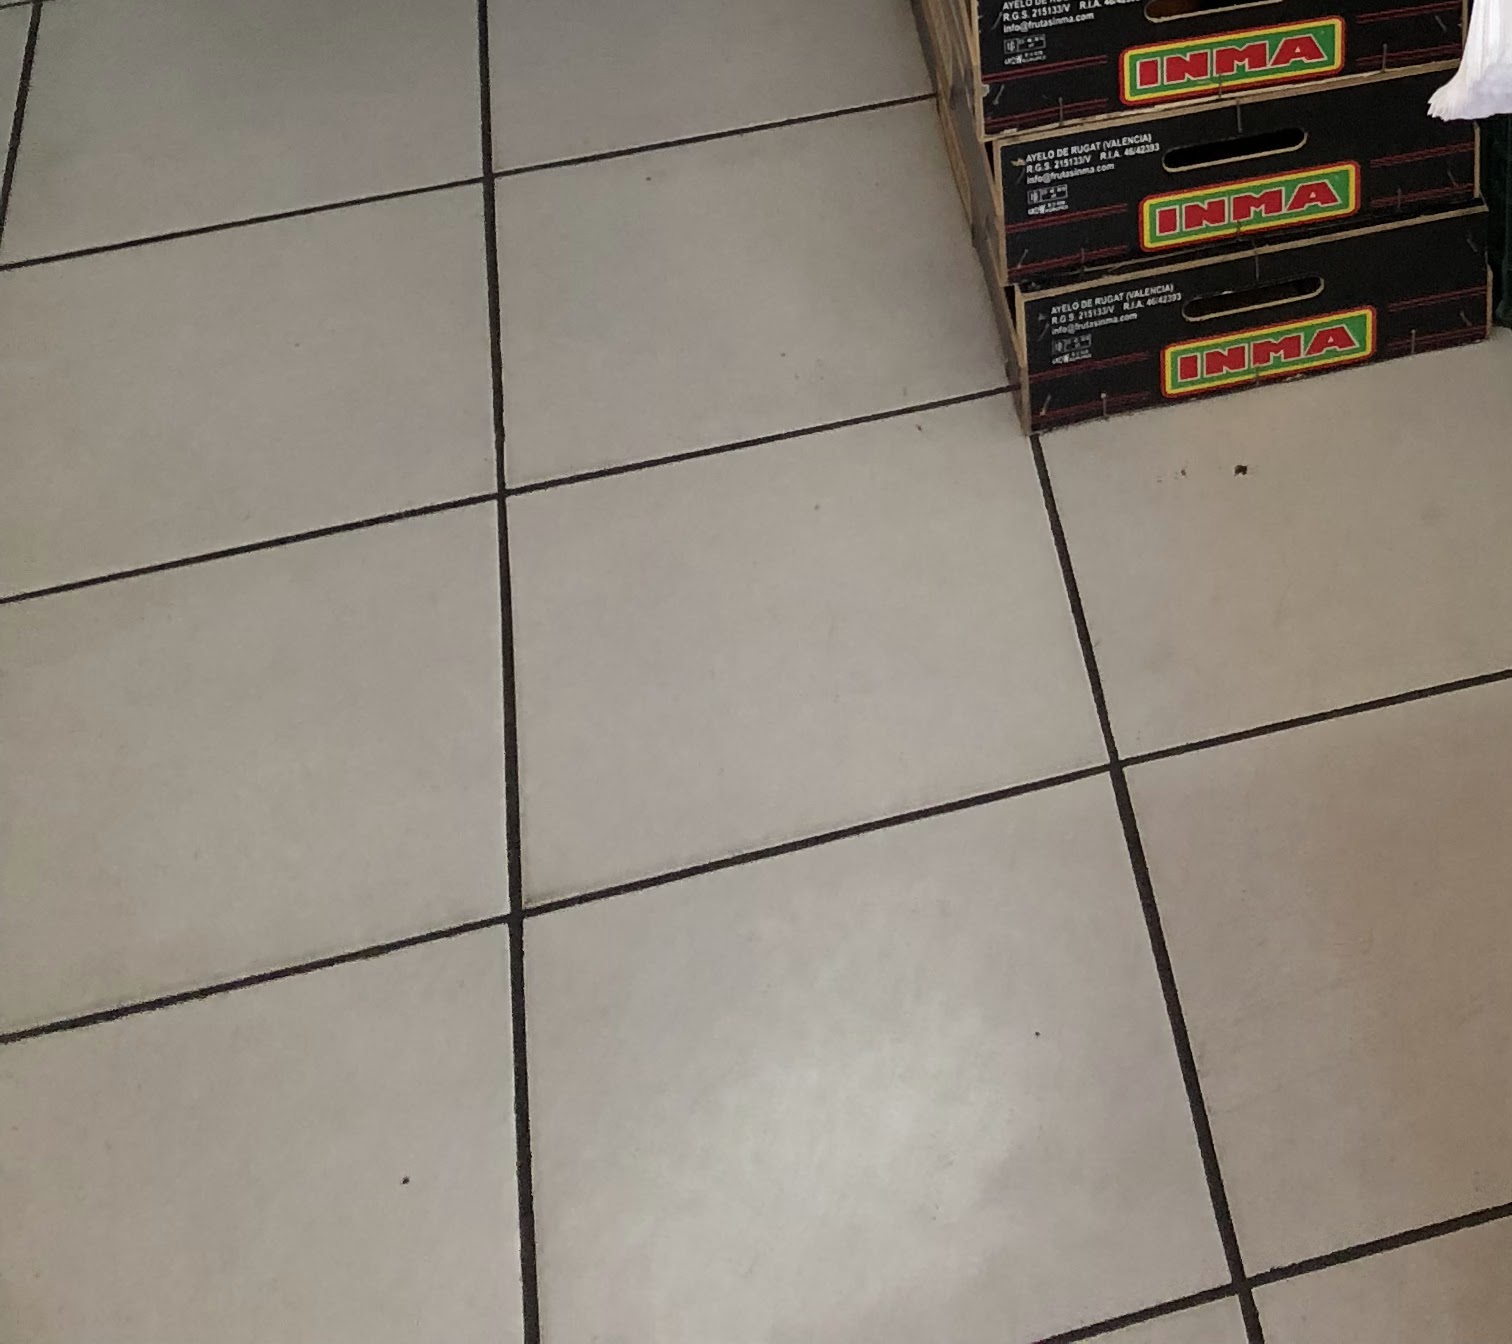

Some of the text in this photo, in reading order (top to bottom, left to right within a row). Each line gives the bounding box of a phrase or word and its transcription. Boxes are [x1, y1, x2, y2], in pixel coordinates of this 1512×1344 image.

[1003, 12, 1095, 33] info@frutasinma.com
[1031, 2, 1071, 18] 215133/V
[1136, 34, 1329, 89] INMA
[1156, 178, 1343, 236] INMA
[1176, 324, 1361, 382] INMA
